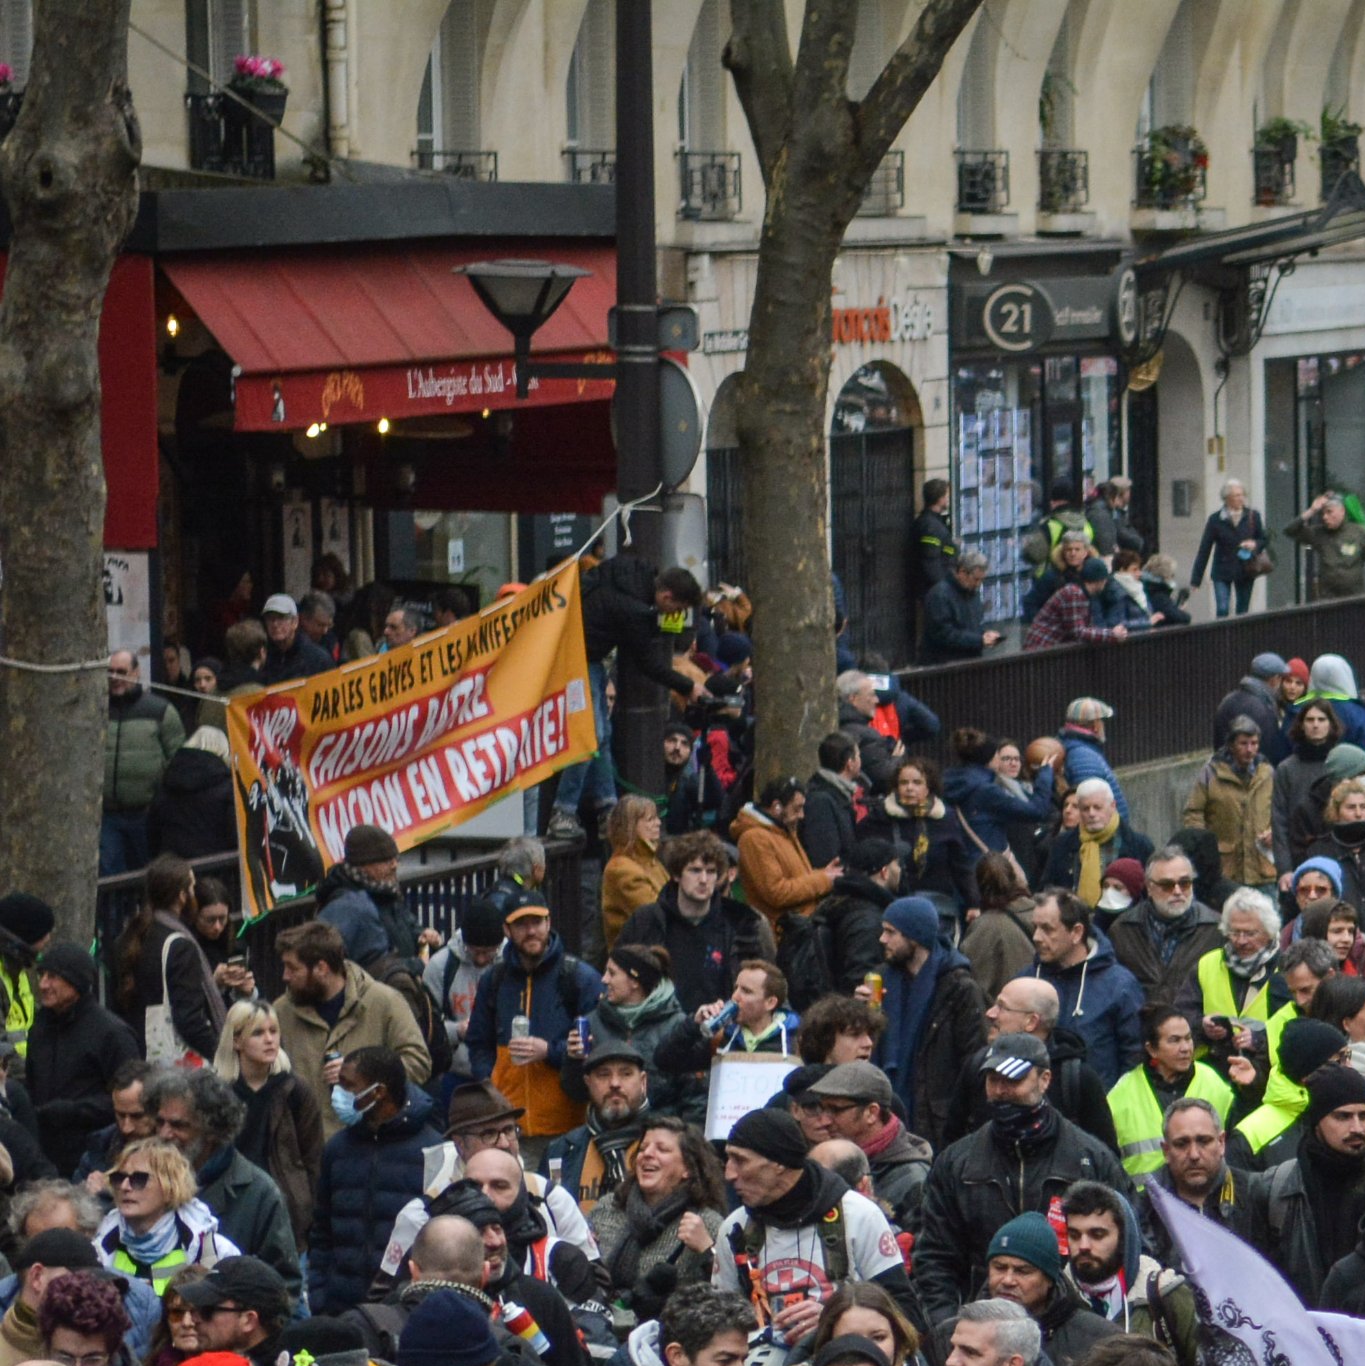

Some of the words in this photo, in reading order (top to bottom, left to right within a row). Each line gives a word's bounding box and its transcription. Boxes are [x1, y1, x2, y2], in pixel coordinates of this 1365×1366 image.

[311, 689, 340, 724] PAR
[341, 676, 364, 712] LES
[369, 658, 415, 704] GRÈVES
[420, 650, 434, 685] ET
[439, 639, 462, 676] LES
[309, 704, 419, 790] FAISONS
[407, 755, 450, 819] EN
